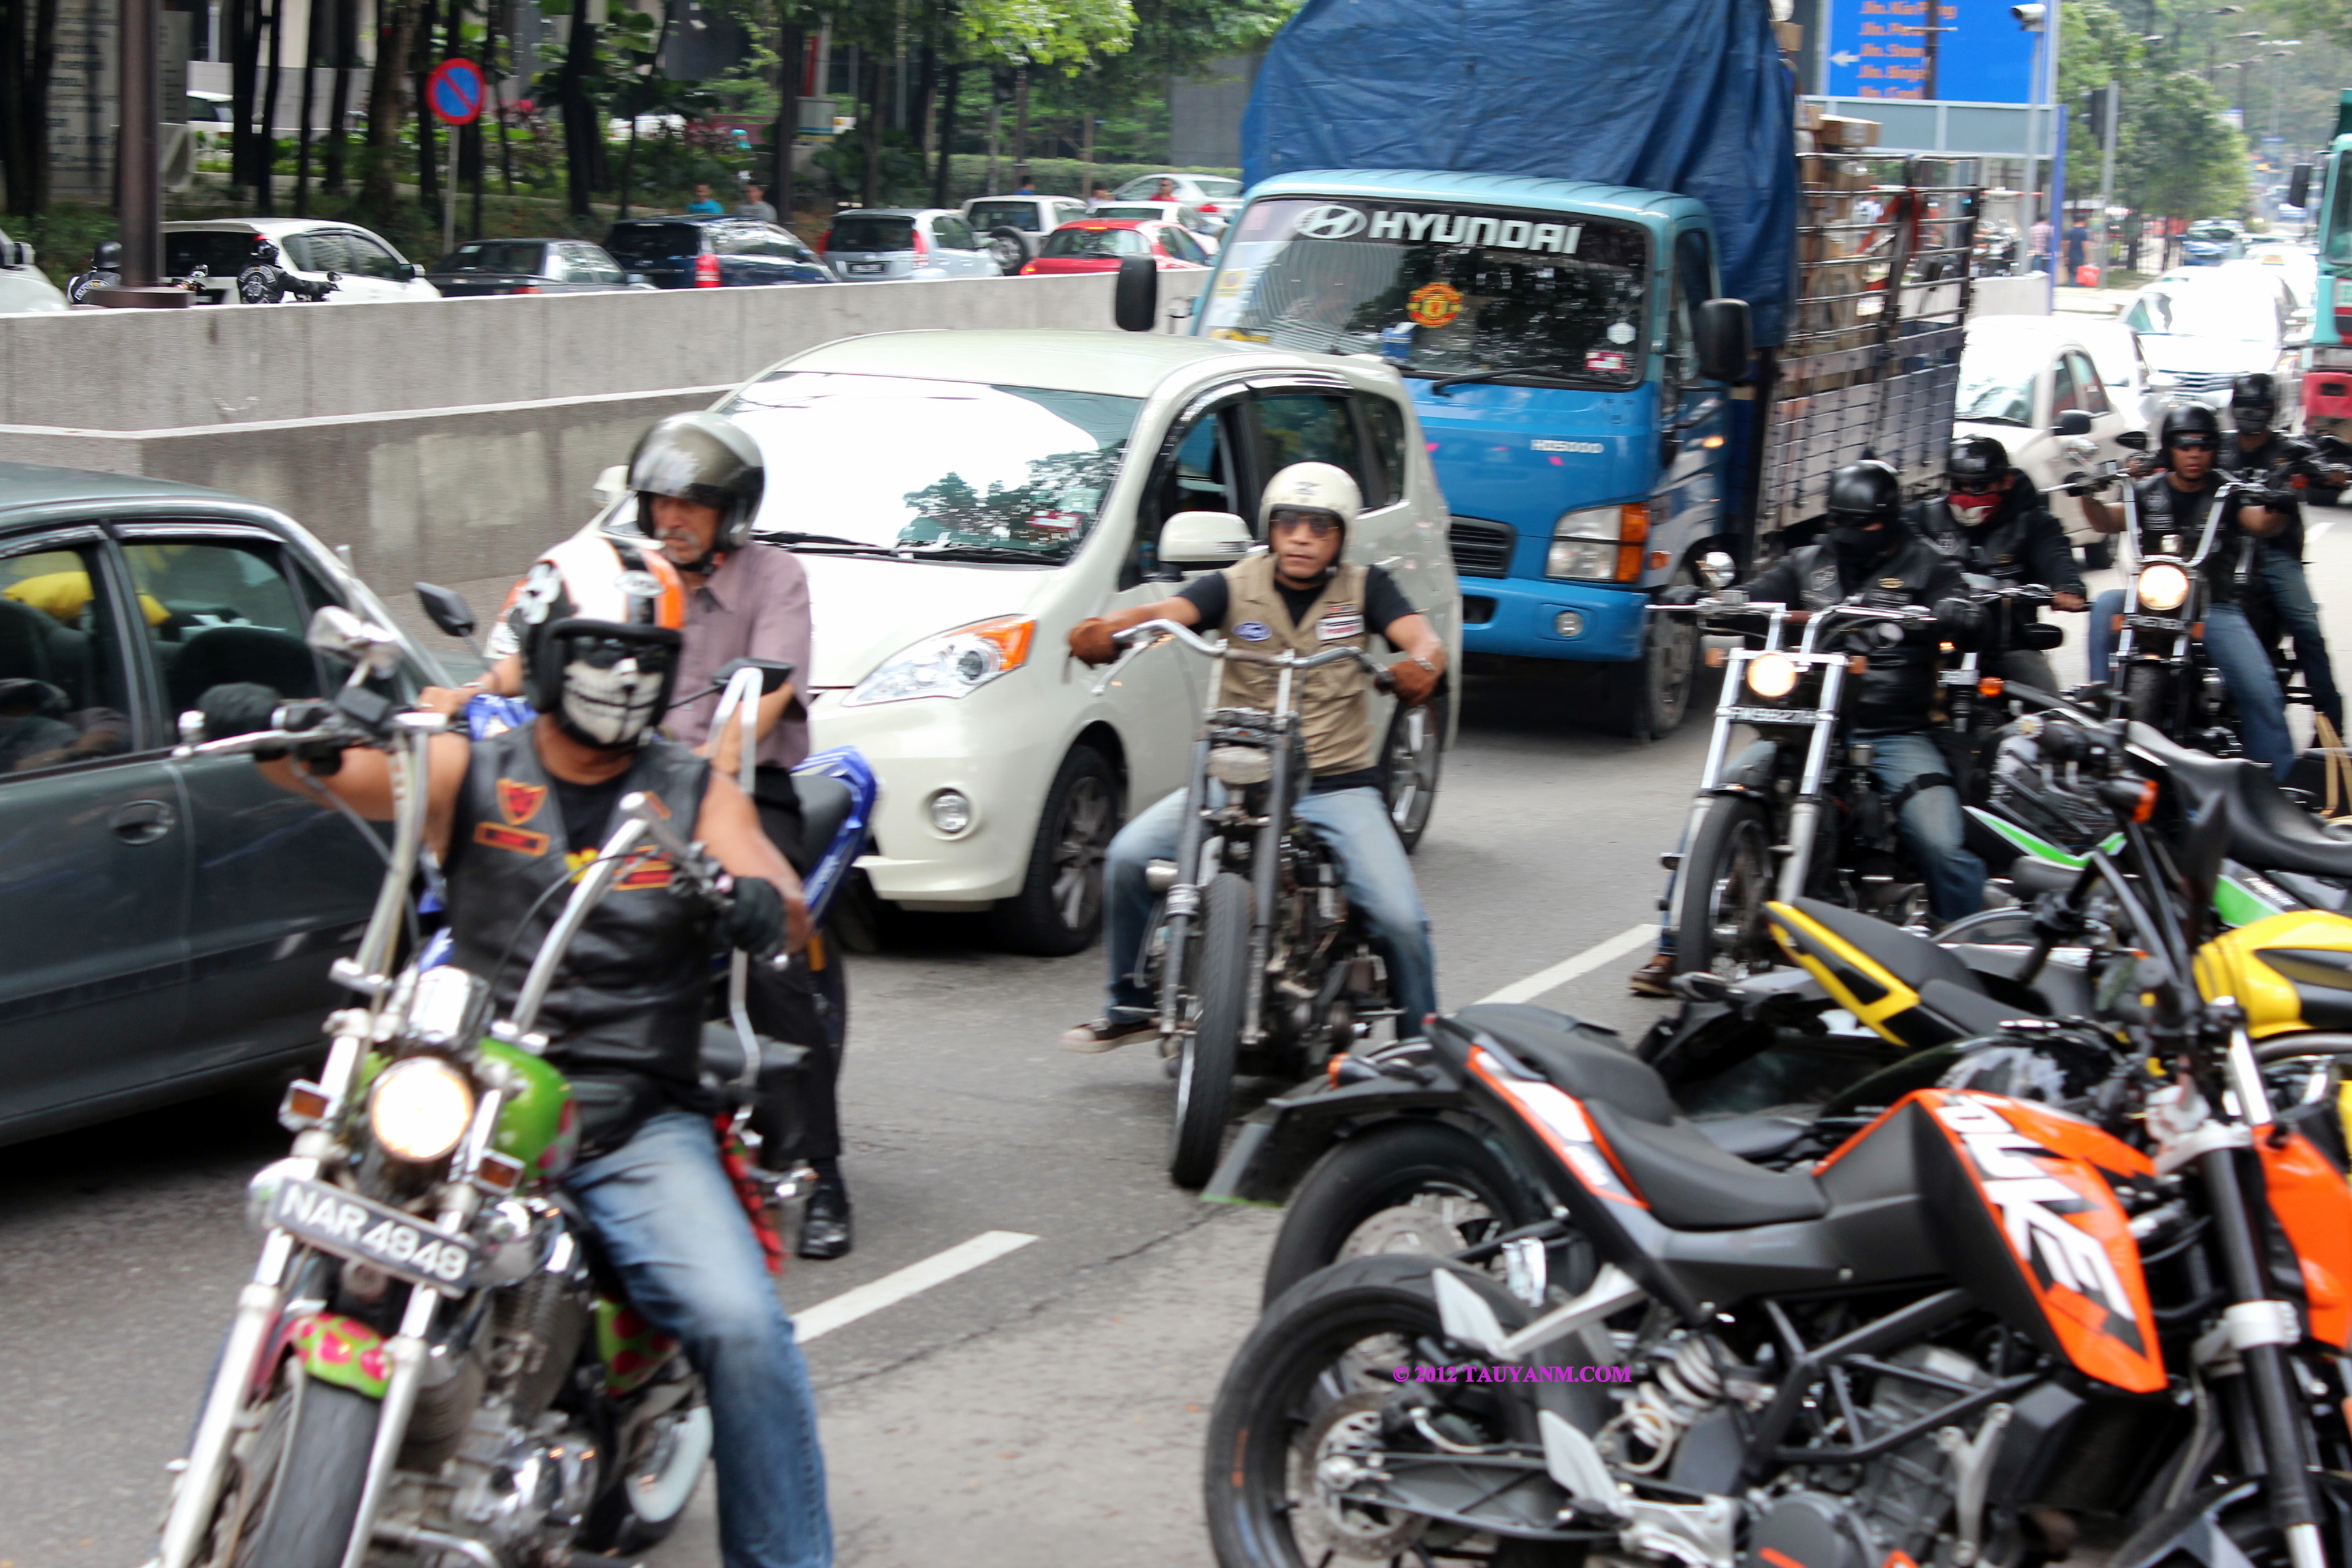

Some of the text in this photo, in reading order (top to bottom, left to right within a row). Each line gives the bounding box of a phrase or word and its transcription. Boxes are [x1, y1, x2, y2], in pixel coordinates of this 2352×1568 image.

[1367, 210, 1582, 254] HYUNDAI
[1936, 1096, 2138, 1322] DUKE
[361, 1220, 470, 1281] 4848
